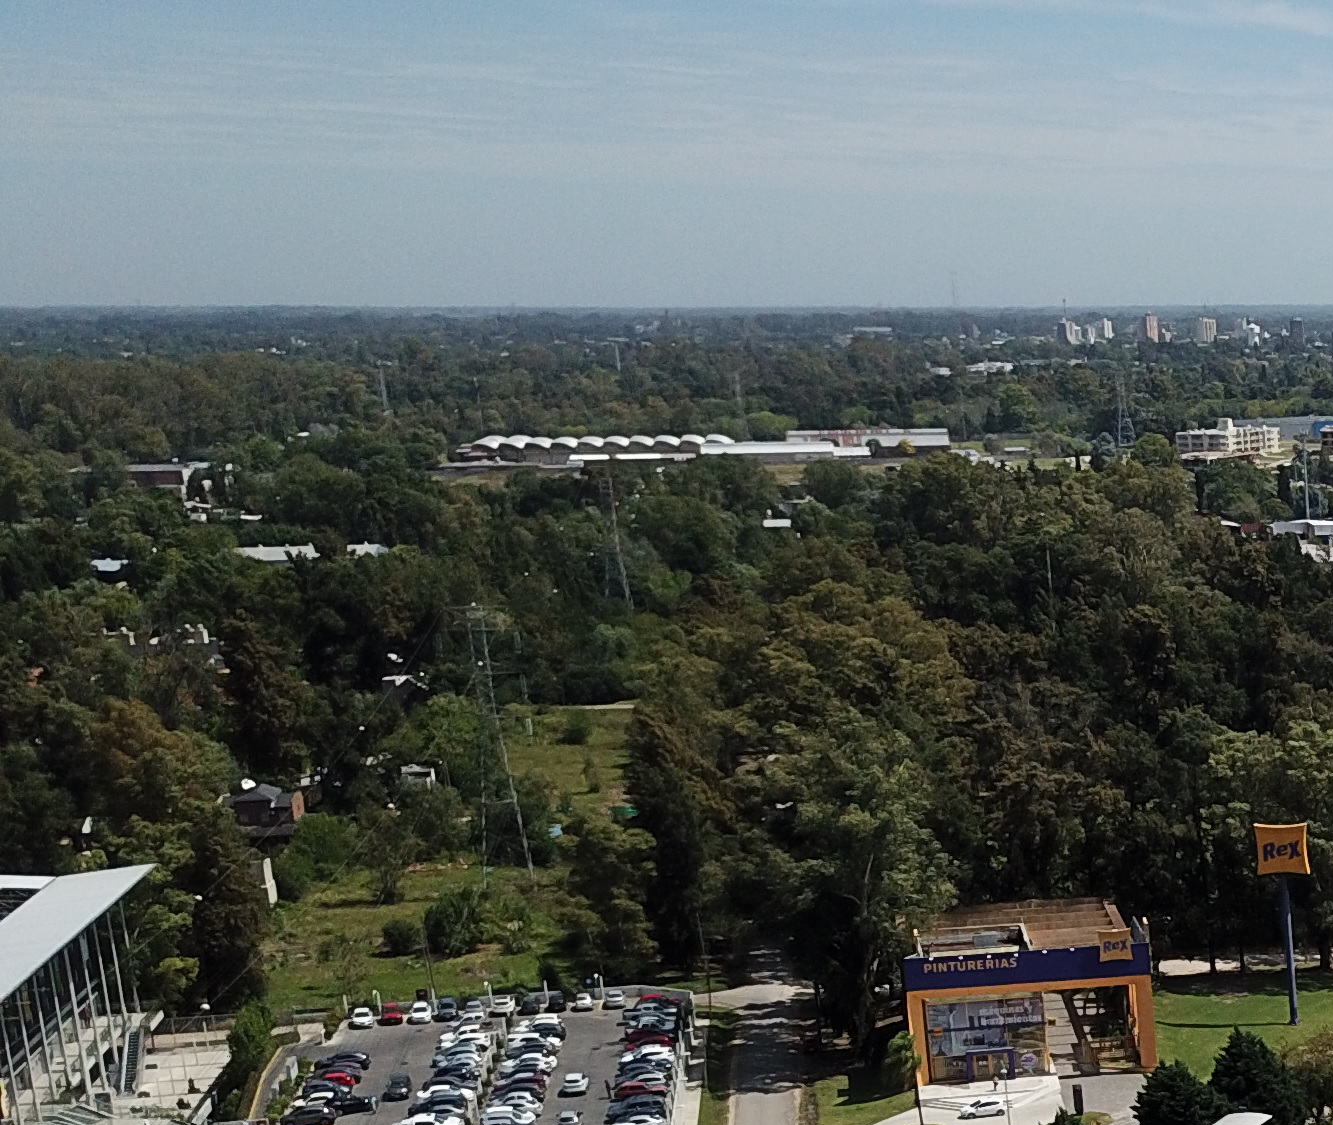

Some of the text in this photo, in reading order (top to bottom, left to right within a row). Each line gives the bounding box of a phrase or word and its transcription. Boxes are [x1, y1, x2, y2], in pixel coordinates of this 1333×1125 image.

[1262, 840, 1302, 862] Rex
[1102, 937, 1129, 954] Rex
[922, 957, 1018, 974] PINTURERIAS
